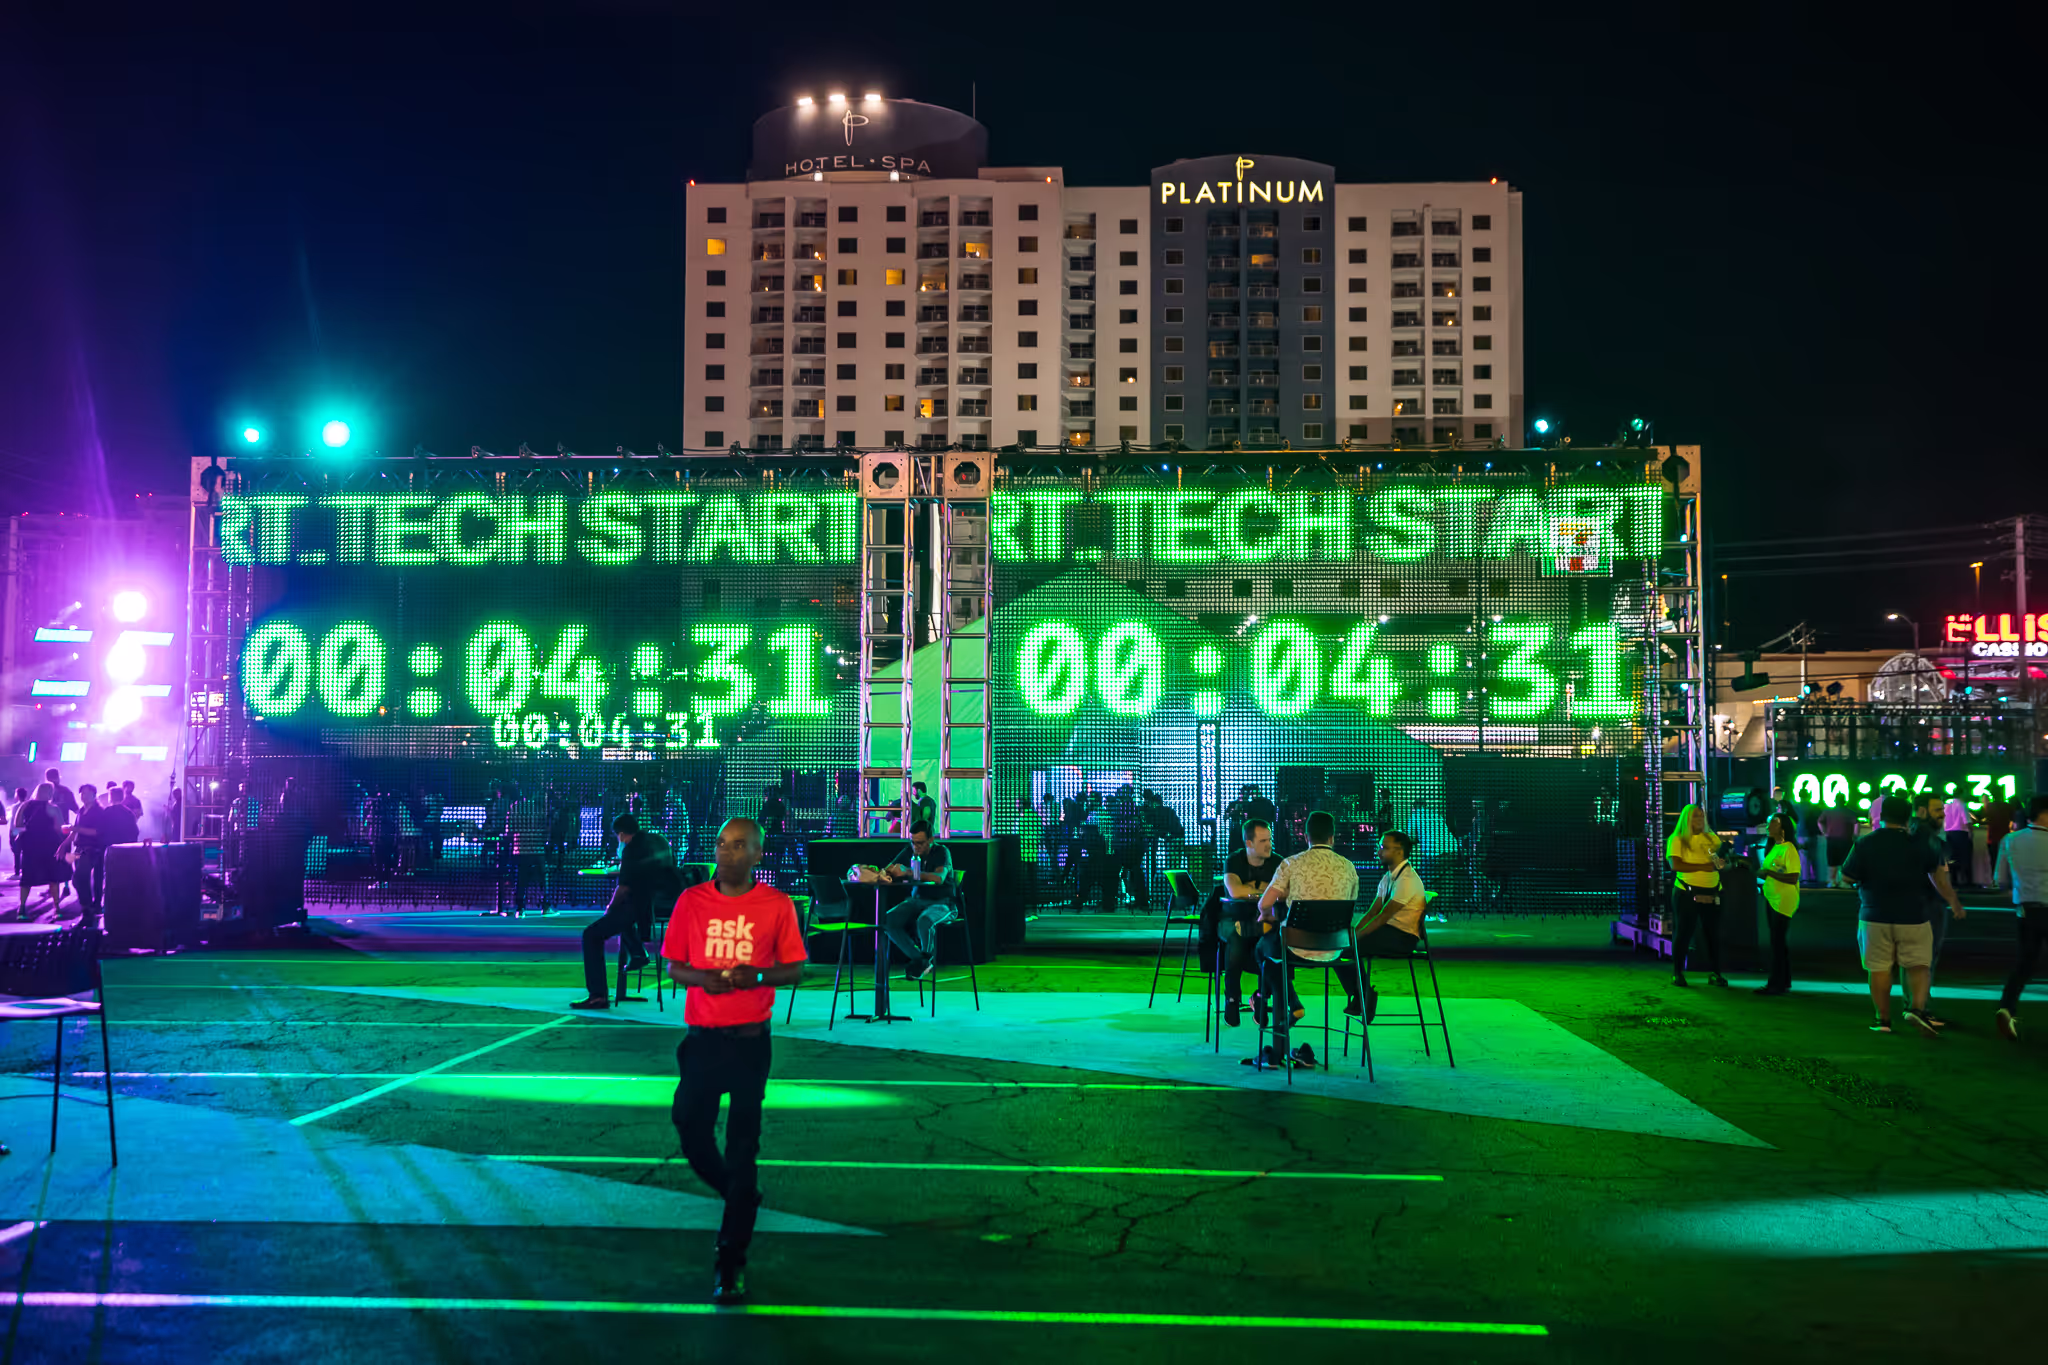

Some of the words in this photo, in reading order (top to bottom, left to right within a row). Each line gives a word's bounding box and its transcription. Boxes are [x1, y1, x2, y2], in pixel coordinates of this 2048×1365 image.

[785, 155, 864, 176] HOTEL
[882, 155, 931, 173] SPA
[1161, 179, 1324, 204] PLATINUM
[576, 489, 857, 564] START
[1363, 483, 1663, 562] START
[242, 620, 832, 718] 00:04:31
[1016, 617, 1639, 719] 00:04:31
[493, 712, 721, 749] 00:04:31
[706, 914, 755, 940] ask
[705, 937, 753, 961] me
